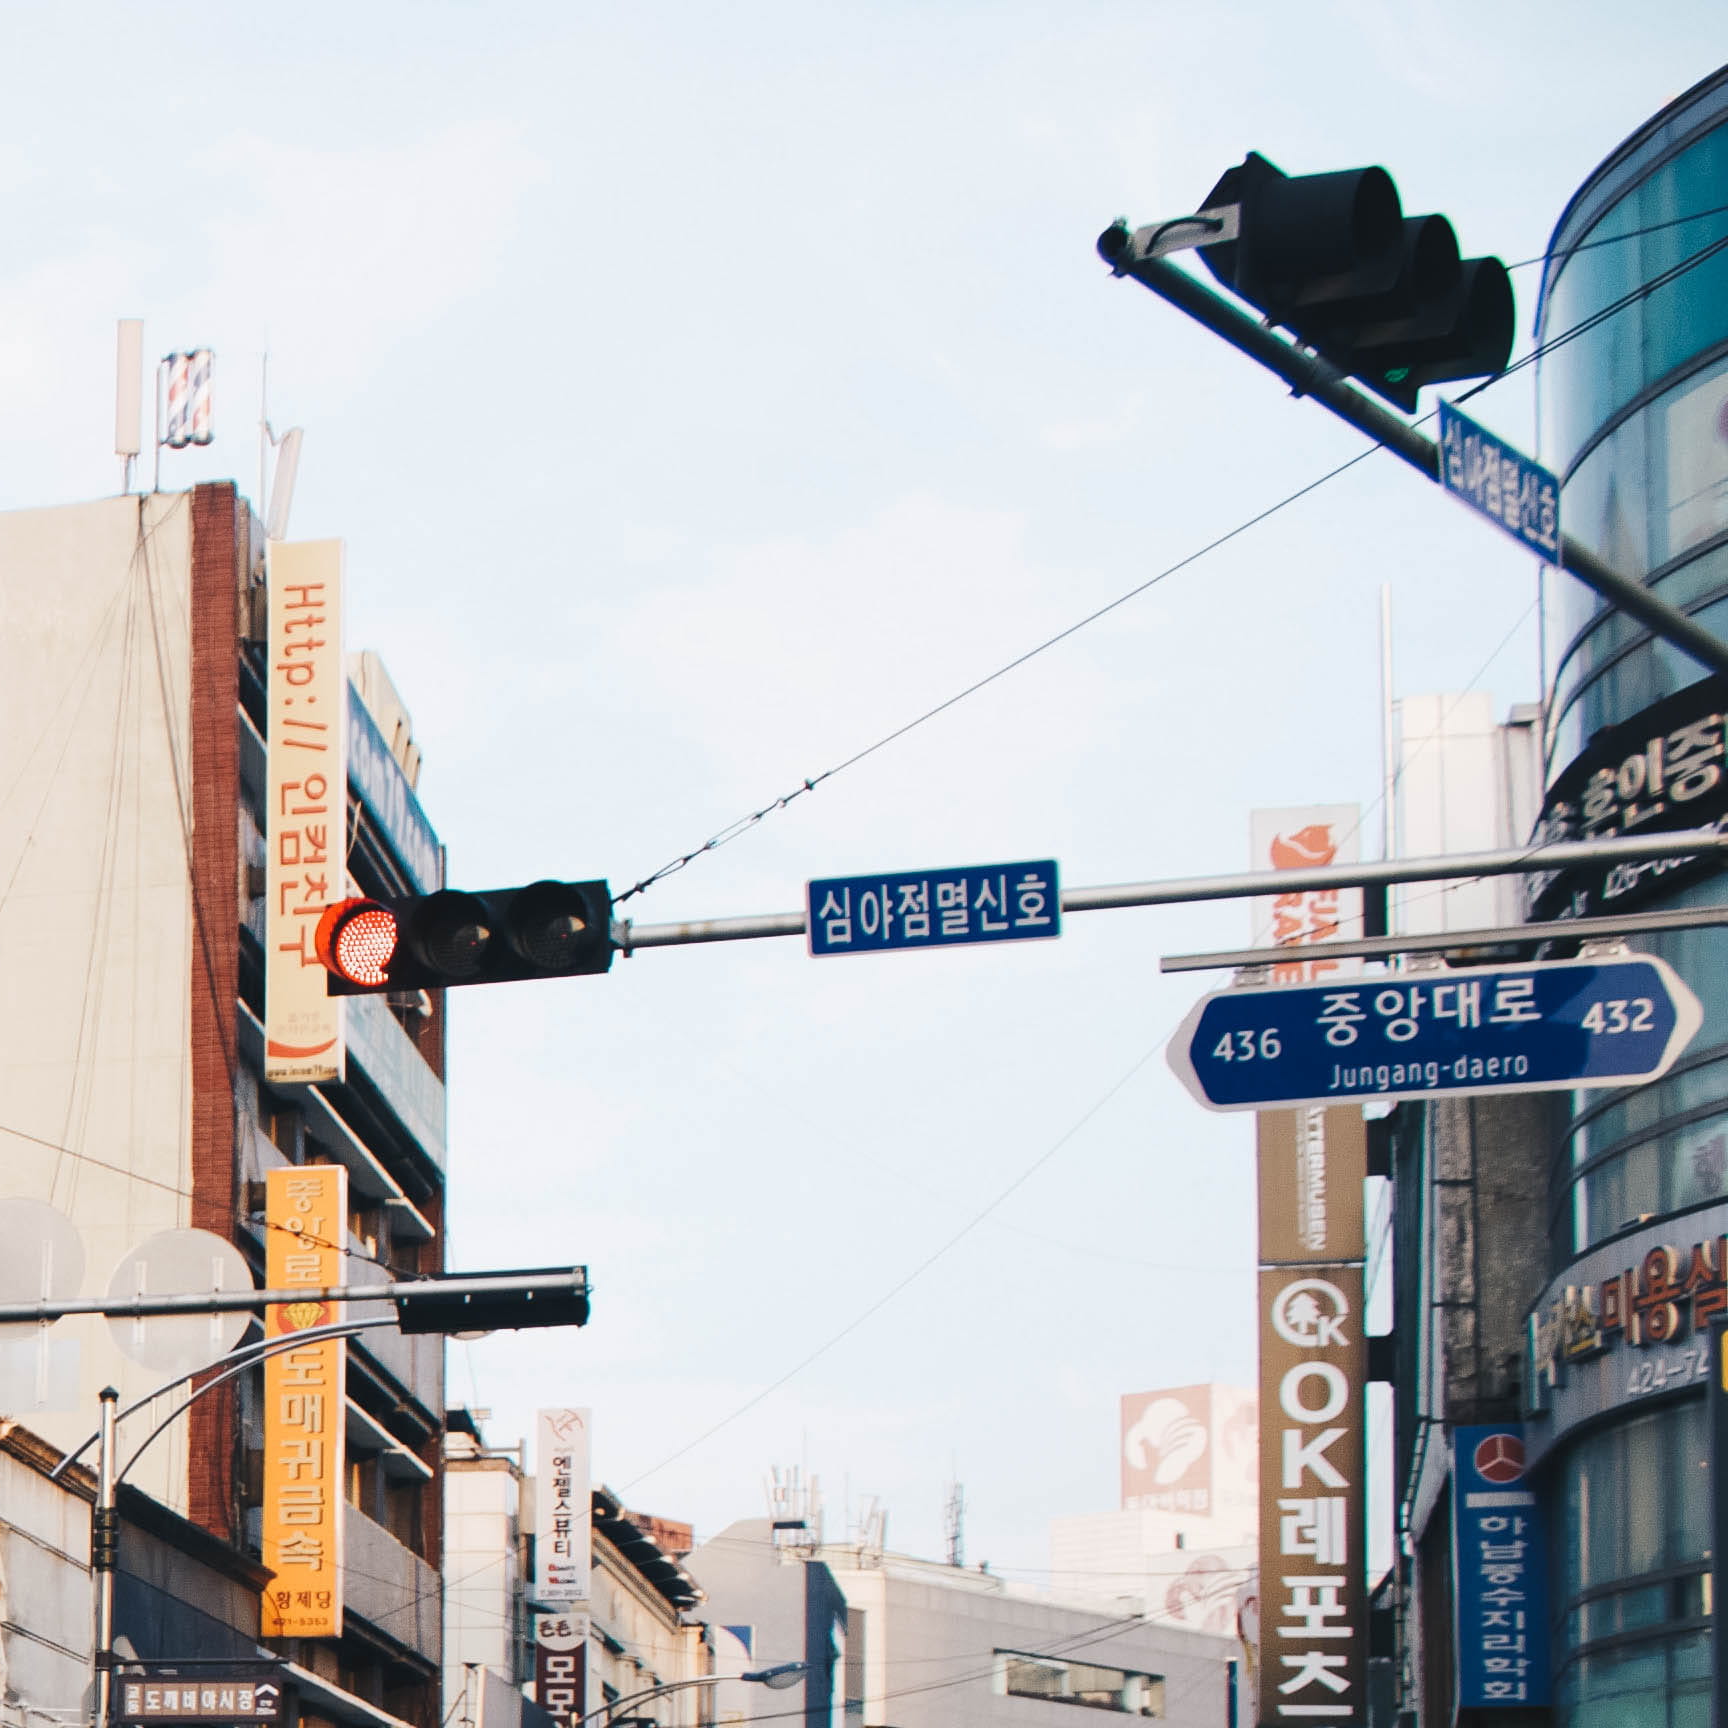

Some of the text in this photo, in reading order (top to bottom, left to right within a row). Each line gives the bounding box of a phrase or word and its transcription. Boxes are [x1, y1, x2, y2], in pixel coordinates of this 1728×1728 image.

[819, 873, 1051, 945] 심야점멸신호
[1213, 1027, 1281, 1062] 436
[1317, 978, 1542, 1047] 중앙대로
[1580, 998, 1656, 1035] 432
[1329, 1053, 1529, 1092] Jungang-daero
[284, 1179, 327, 1284] 중앙로
[277, 1349, 328, 1573] 도매귀금속
[1276, 1360, 1354, 1717] OK레포츠
